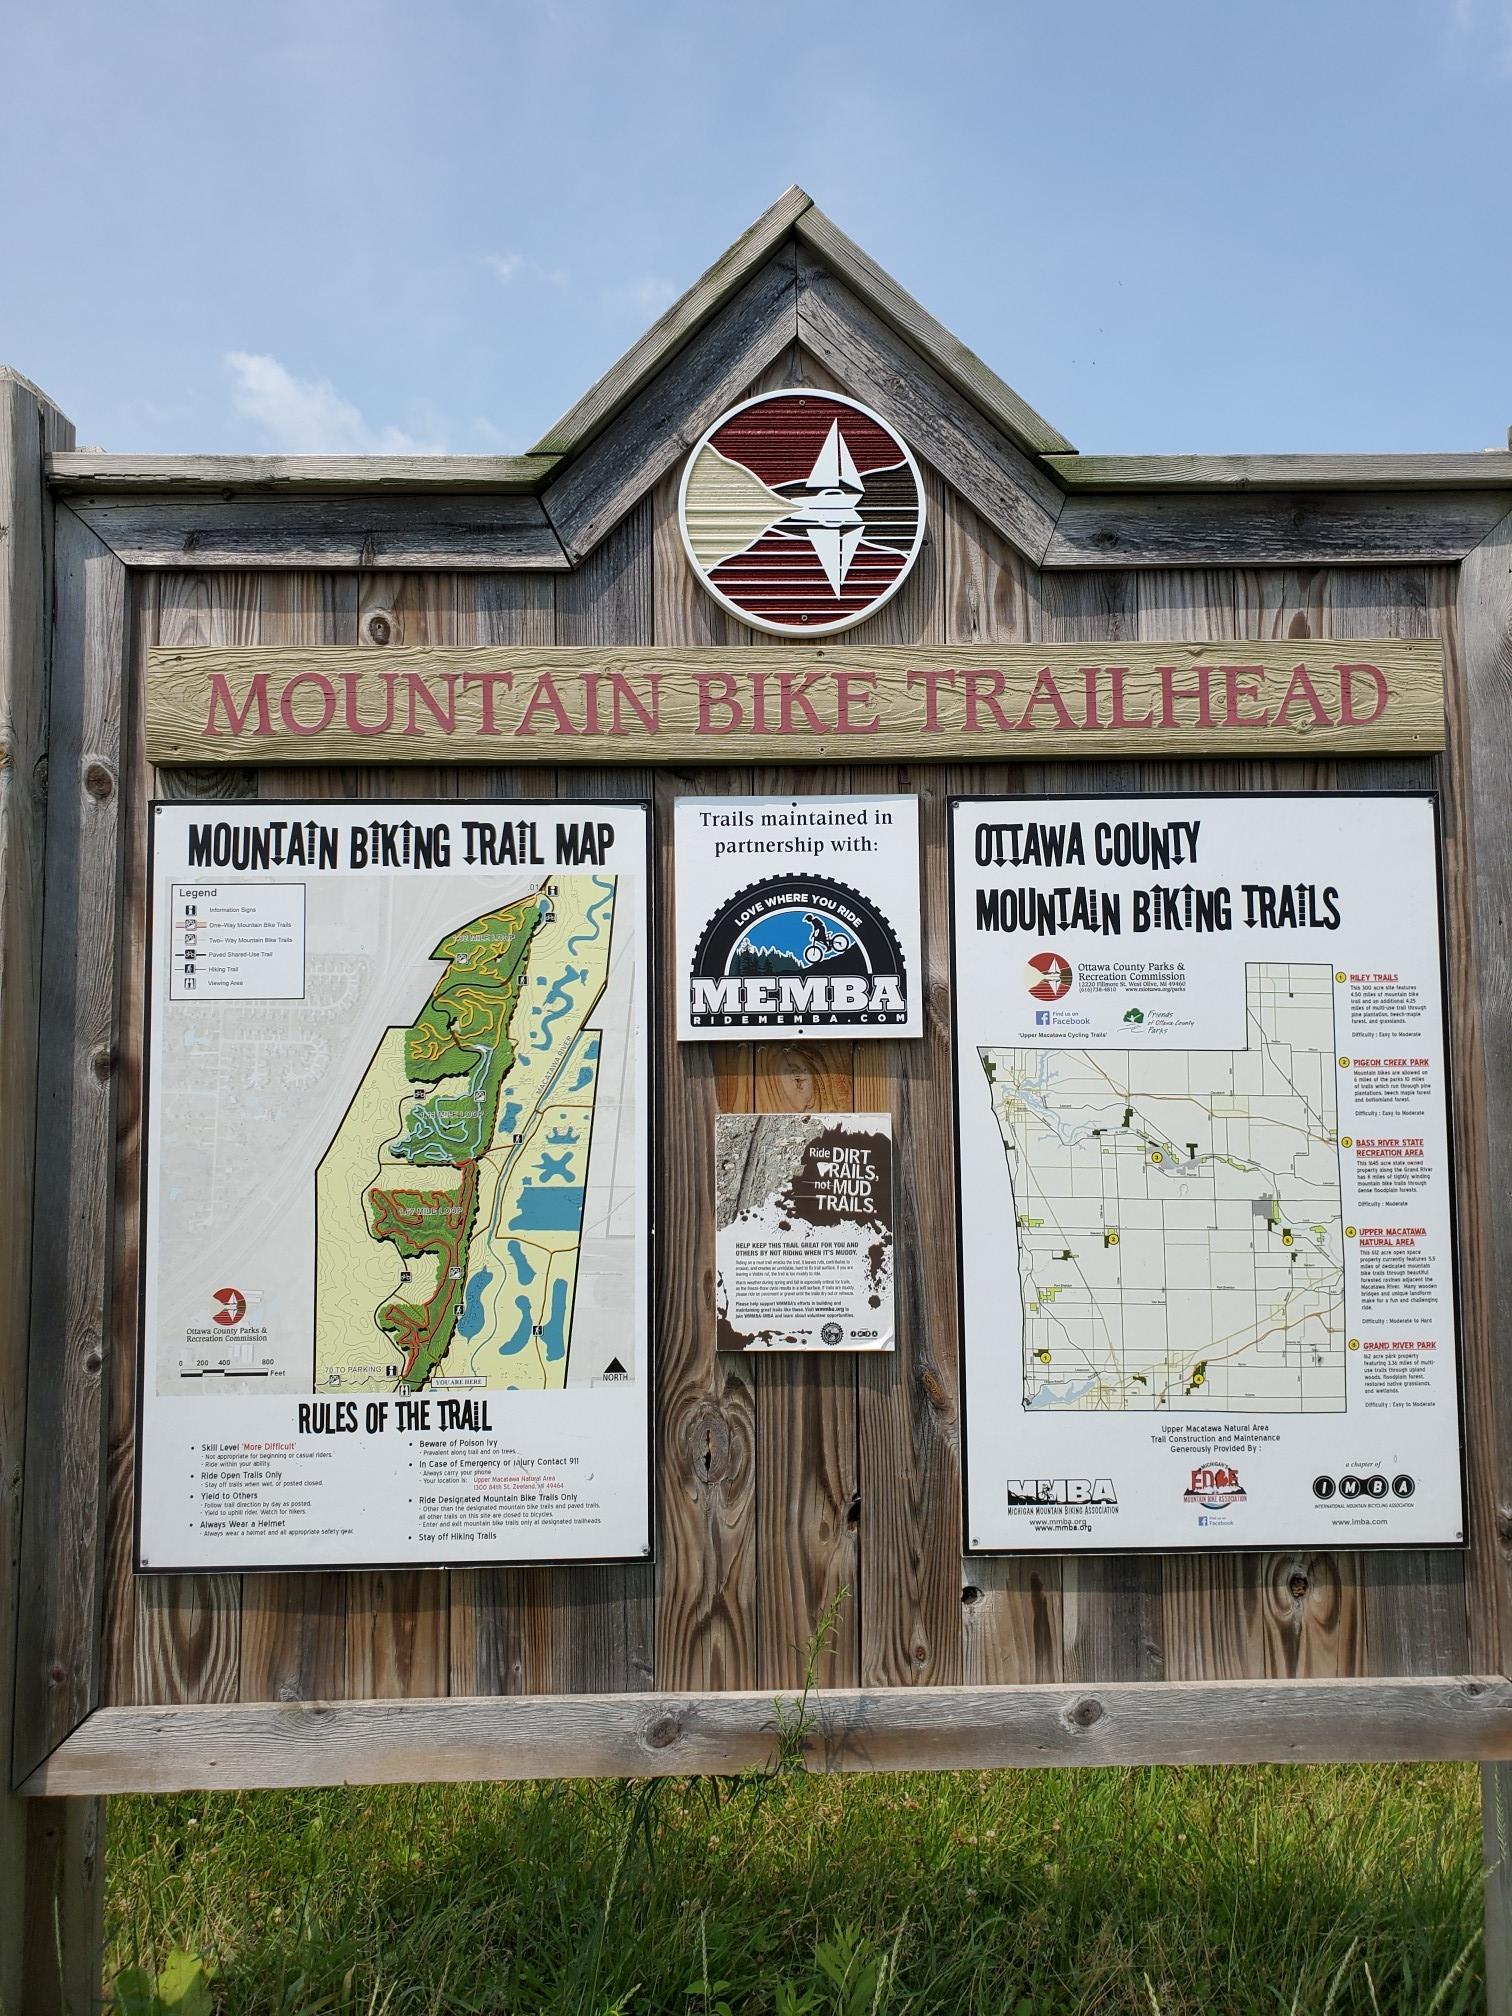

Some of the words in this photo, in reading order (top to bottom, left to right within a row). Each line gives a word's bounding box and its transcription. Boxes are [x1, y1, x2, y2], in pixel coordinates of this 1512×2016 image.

[204, 671, 661, 737] MOUNTAIN
[692, 671, 881, 737] BIKE
[907, 663, 1388, 734] TRAILHEAD
[700, 812, 754, 827] Trails
[762, 810, 867, 826] maintained
[875, 810, 892, 824] in
[188, 820, 338, 870] MOUNTAIN
[351, 820, 450, 869] BIKING
[462, 820, 544, 866] TRAIL
[556, 821, 614, 866] MAP
[715, 837, 824, 857] partnership
[831, 836, 878, 852] with:
[975, 821, 1085, 868] OTTAWA
[1094, 820, 1200, 870] COUNTY
[180, 888, 217, 899] Legend
[735, 902, 764, 927] LOVE
[765, 893, 809, 906] WHERE
[812, 895, 837, 910] YOU
[837, 906, 862, 928] RIDE
[976, 886, 1120, 936] MOUNTAIN
[1133, 883, 1232, 933] BIKING
[1241, 882, 1341, 930] TRAILS
[1078, 963, 1110, 971] Ottawa
[1113, 963, 1146, 972] County
[1148, 962, 1174, 971] Parks
[1178, 963, 1185, 971] &
[1079, 973, 1127, 981] Recreation
[1130, 972, 1185, 981] Commission
[691, 975, 905, 1013] MEMBA
[694, 1014, 905, 1025] RIDEMEMBA.COM
[536, 1057, 560, 1094] MACATAWA
[558, 1035, 572, 1056] RIVER
[810, 1148, 830, 1157] Ride
[833, 1147, 871, 1164] DIRT
[1356, 1149, 1402, 1157] RECREATION
[815, 1180, 831, 1189] not
[833, 1179, 871, 1196] MUD
[816, 1195, 877, 1213] TRAILS.
[299, 1402, 357, 1434] RULES
[366, 1402, 388, 1434] OF
[395, 1400, 430, 1433] THE
[437, 1399, 492, 1432] TRAIL
[1162, 1426, 1183, 1434] Upper
[202, 1444, 217, 1452] Skill
[220, 1443, 239, 1451] Level
[419, 1440, 446, 1448] Beware
[487, 1439, 497, 1448] Ivy
[1171, 1445, 1211, 1453] Generously
[460, 1459, 500, 1469] Emergency
[538, 1458, 567, 1466] Contact
[220, 1472, 240, 1480] Open
[243, 1471, 262, 1479] Trails
[265, 1471, 282, 1480] Only
[201, 1492, 220, 1500] Yield
[233, 1492, 258, 1500] Others
[1007, 1479, 1117, 1505] MMBA
[419, 1496, 436, 1504] Ride
[439, 1496, 480, 1505] Designated
[483, 1495, 518, 1503] Mountain
[561, 1494, 578, 1503] Only
[1008, 1506, 1033, 1515] MICHIGAN
[1036, 1506, 1062, 1515] MOUNTAIN
[1065, 1506, 1083, 1514] BIKING
[1085, 1506, 1119, 1514] ASSOCIATION
[200, 1521, 226, 1529] Always
[258, 1520, 285, 1528] Helmet
[419, 1534, 435, 1542] Stay
[438, 1533, 448, 1541] off
[451, 1533, 474, 1542] Hiking
